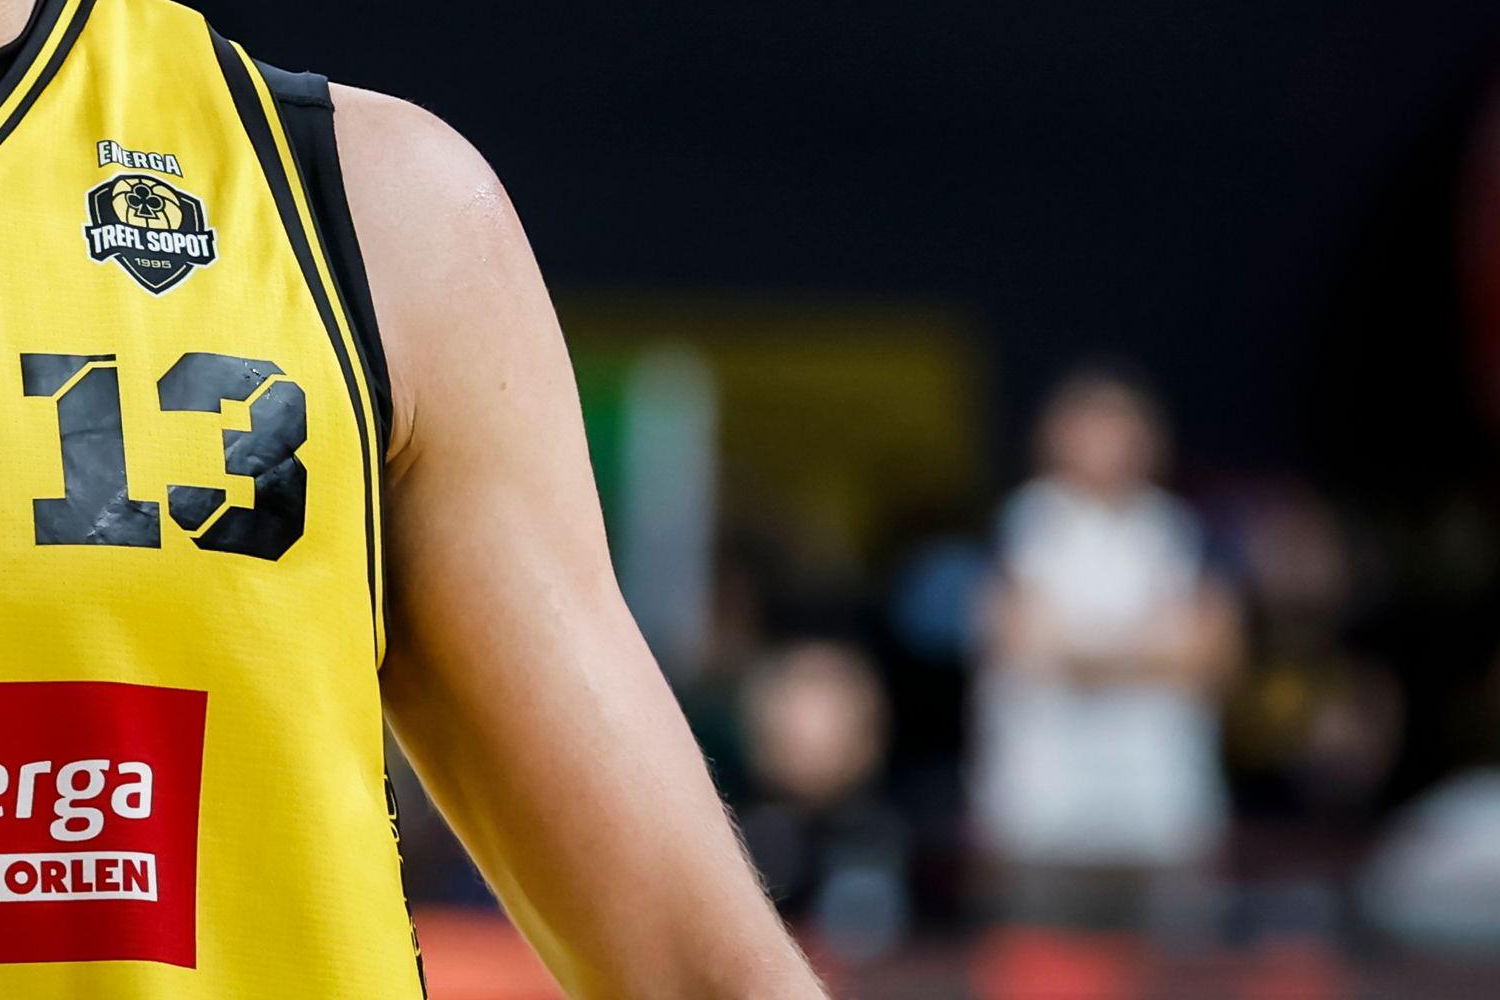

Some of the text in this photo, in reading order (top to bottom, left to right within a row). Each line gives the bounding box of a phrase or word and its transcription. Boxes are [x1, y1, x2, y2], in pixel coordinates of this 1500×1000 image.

[97, 140, 183, 178] ENERGA
[91, 224, 209, 257] TREFL SOPOT
[134, 257, 172, 269] 1995
[20, 353, 307, 562] 13
[4, 860, 149, 894] ORLEN
